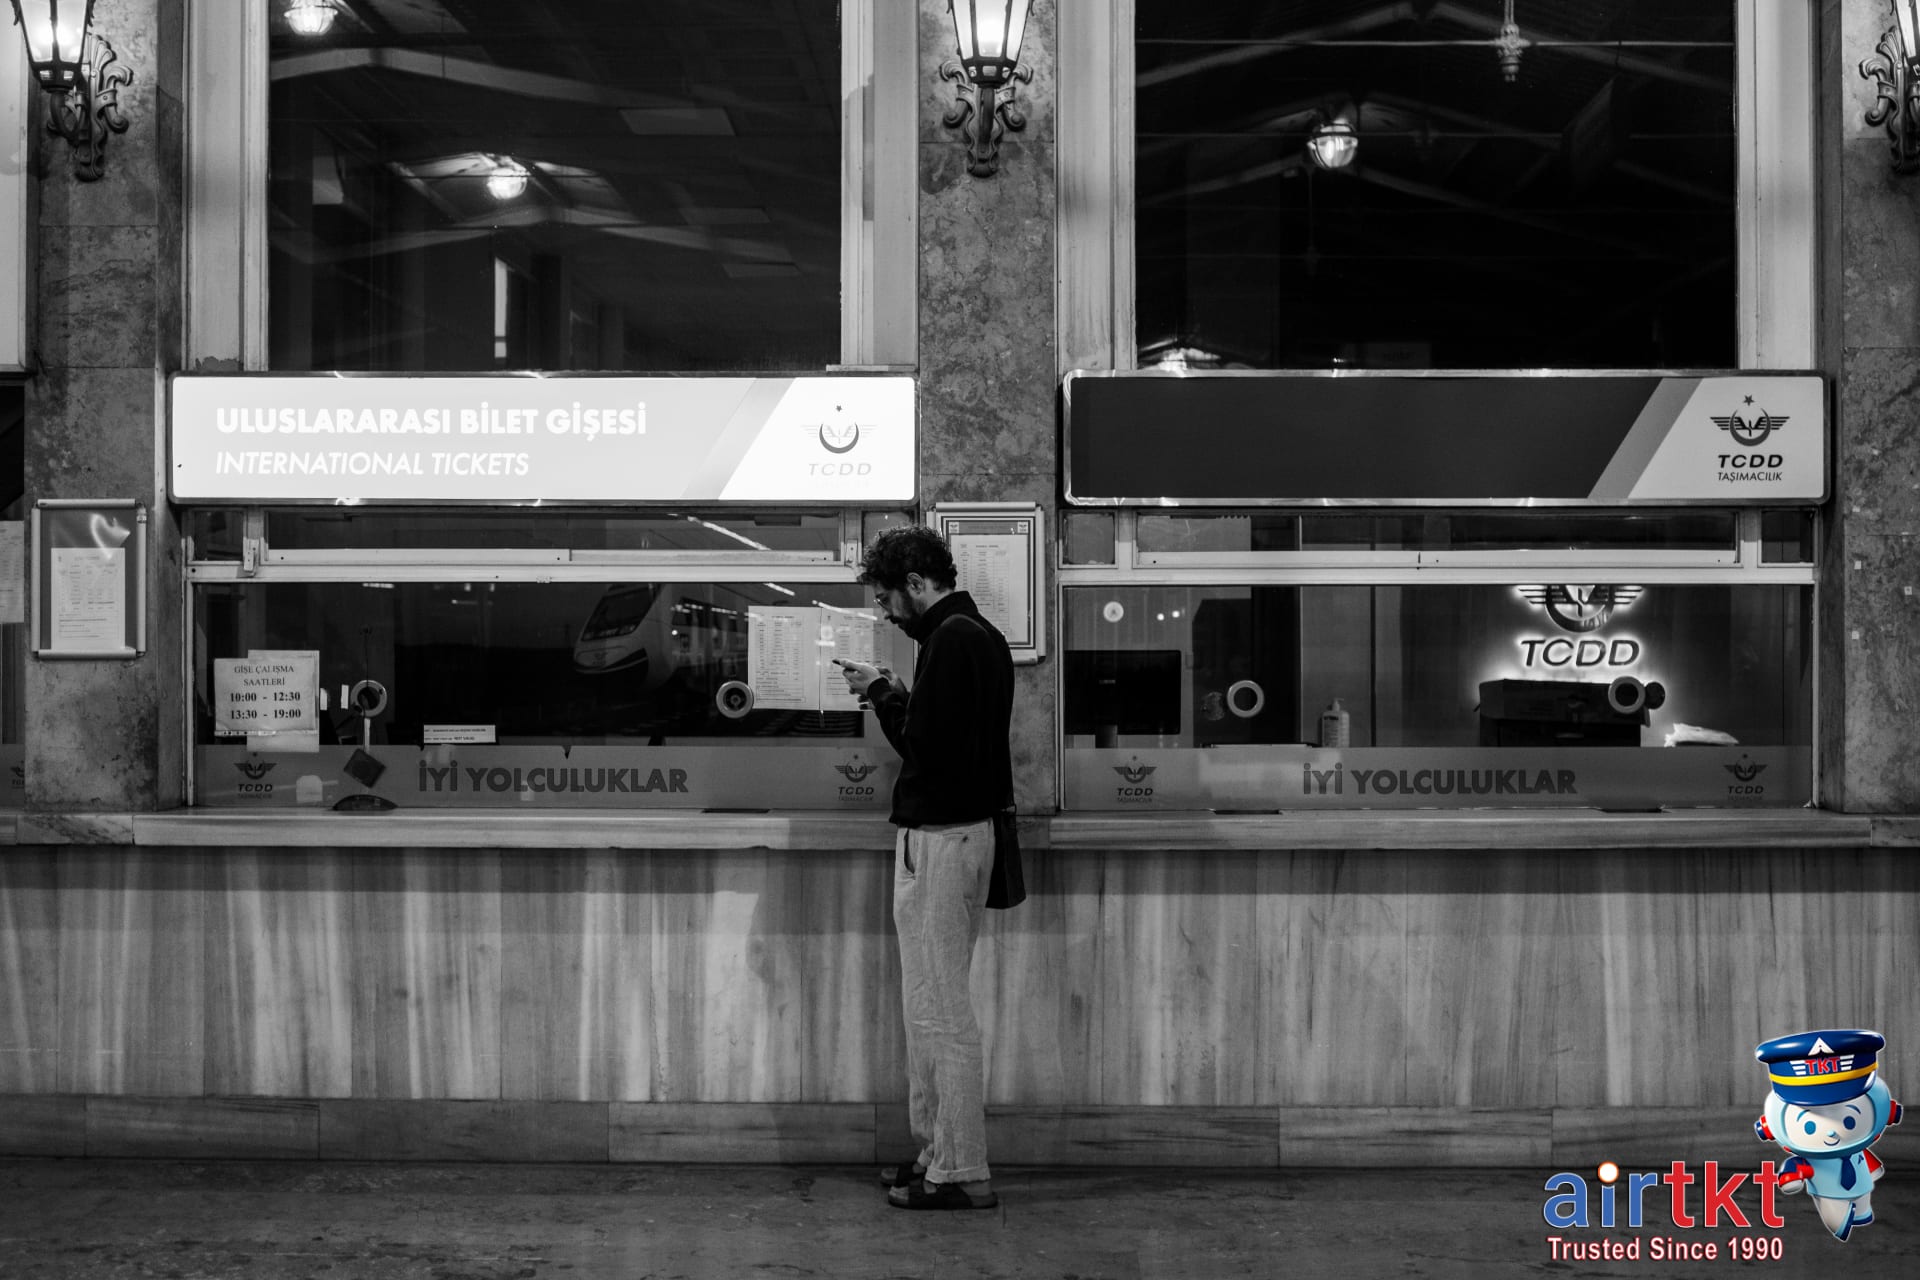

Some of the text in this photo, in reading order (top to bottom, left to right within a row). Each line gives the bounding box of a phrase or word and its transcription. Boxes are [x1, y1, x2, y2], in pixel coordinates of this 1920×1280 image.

[216, 402, 647, 442] ULUSLARARASI BİLET GİŞESİ
[215, 451, 529, 477] INTERNATIONAL TICKETS
[1718, 454, 1784, 469] TCDD
[808, 463, 872, 476] TCDD
[1717, 471, 1783, 483] TAŞIMACILIK
[1521, 639, 1640, 667] TCDD
[229, 692, 257, 702] 10:00
[273, 691, 301, 701] 12:30
[230, 709, 258, 720] 13:30
[273, 708, 302, 719] 19:00
[419, 759, 689, 793] İYİ YOLCULUKLAR
[1303, 762, 1577, 795] İYİ YOLCULUKLAR
[238, 783, 273, 792] TCDD
[838, 786, 875, 795] TCDD
[1117, 787, 1154, 796] TCDD
[1727, 785, 1764, 794] TCDD
